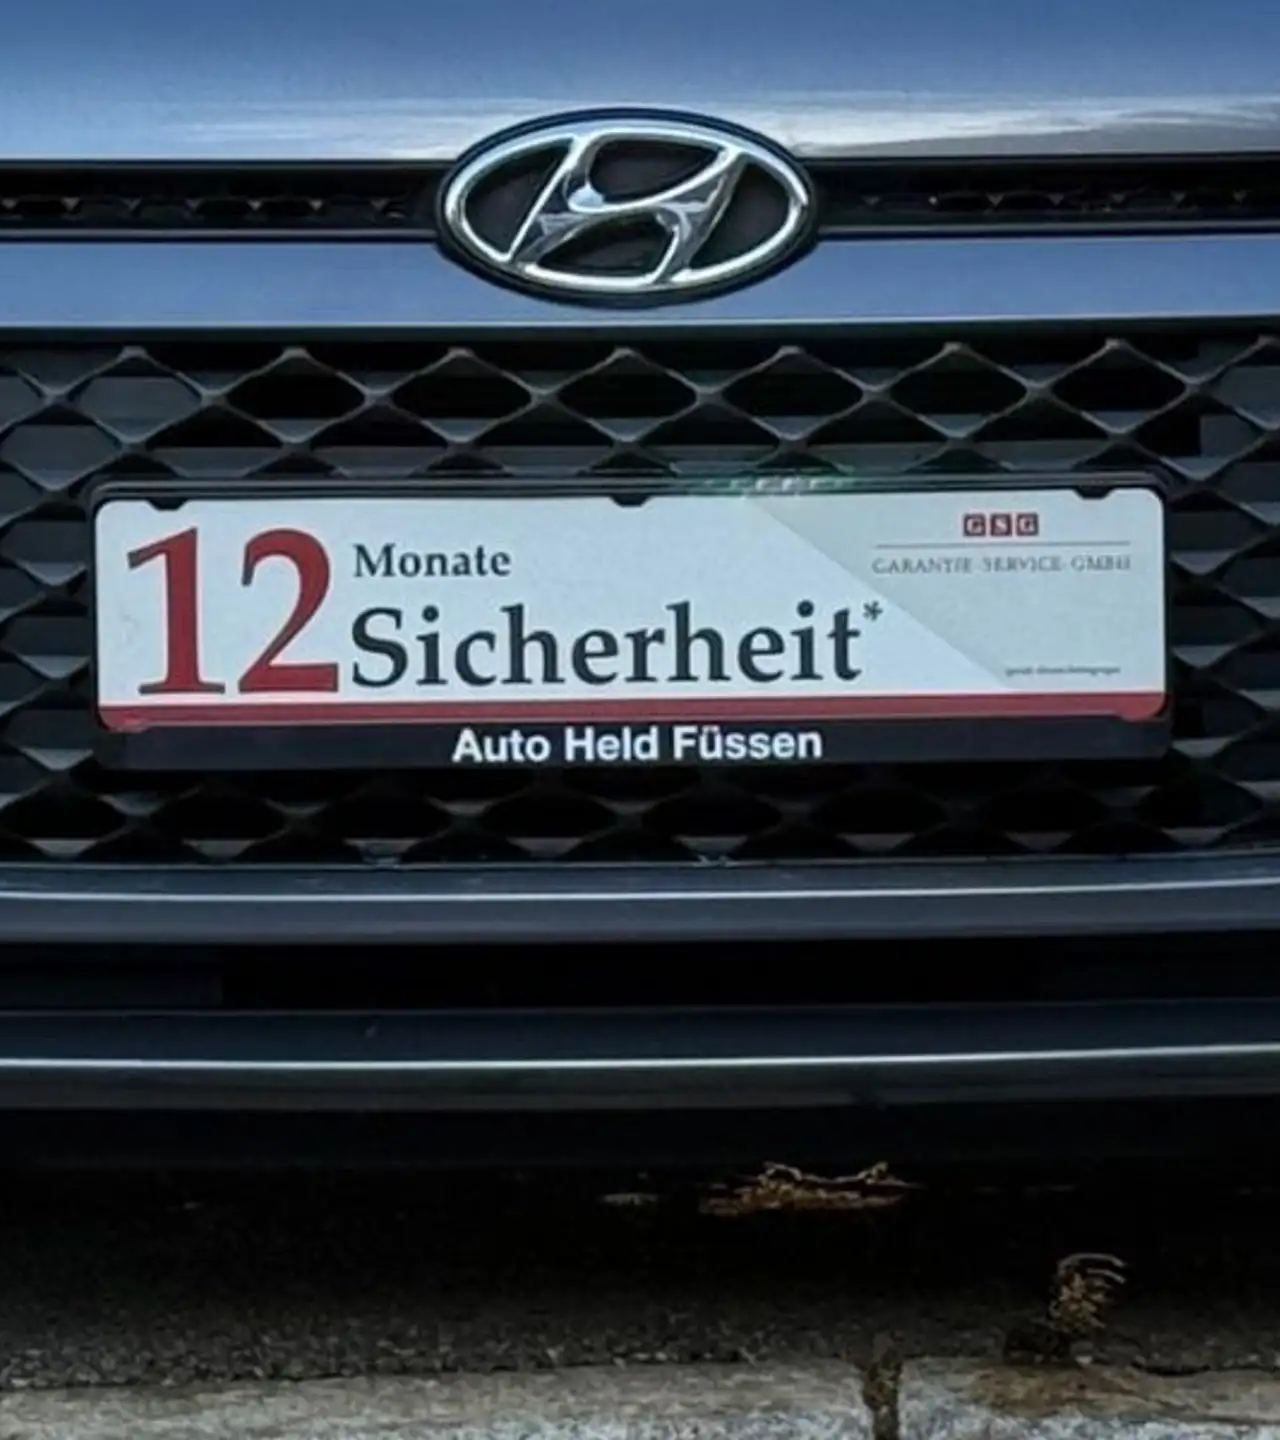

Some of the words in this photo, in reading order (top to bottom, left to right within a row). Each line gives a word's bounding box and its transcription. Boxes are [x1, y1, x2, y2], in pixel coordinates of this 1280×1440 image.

[353, 543, 512, 578] Monate
[127, 527, 340, 695] 12
[452, 727, 552, 763] Auto
[563, 725, 659, 761] Held
[673, 724, 823, 759] Füssen
